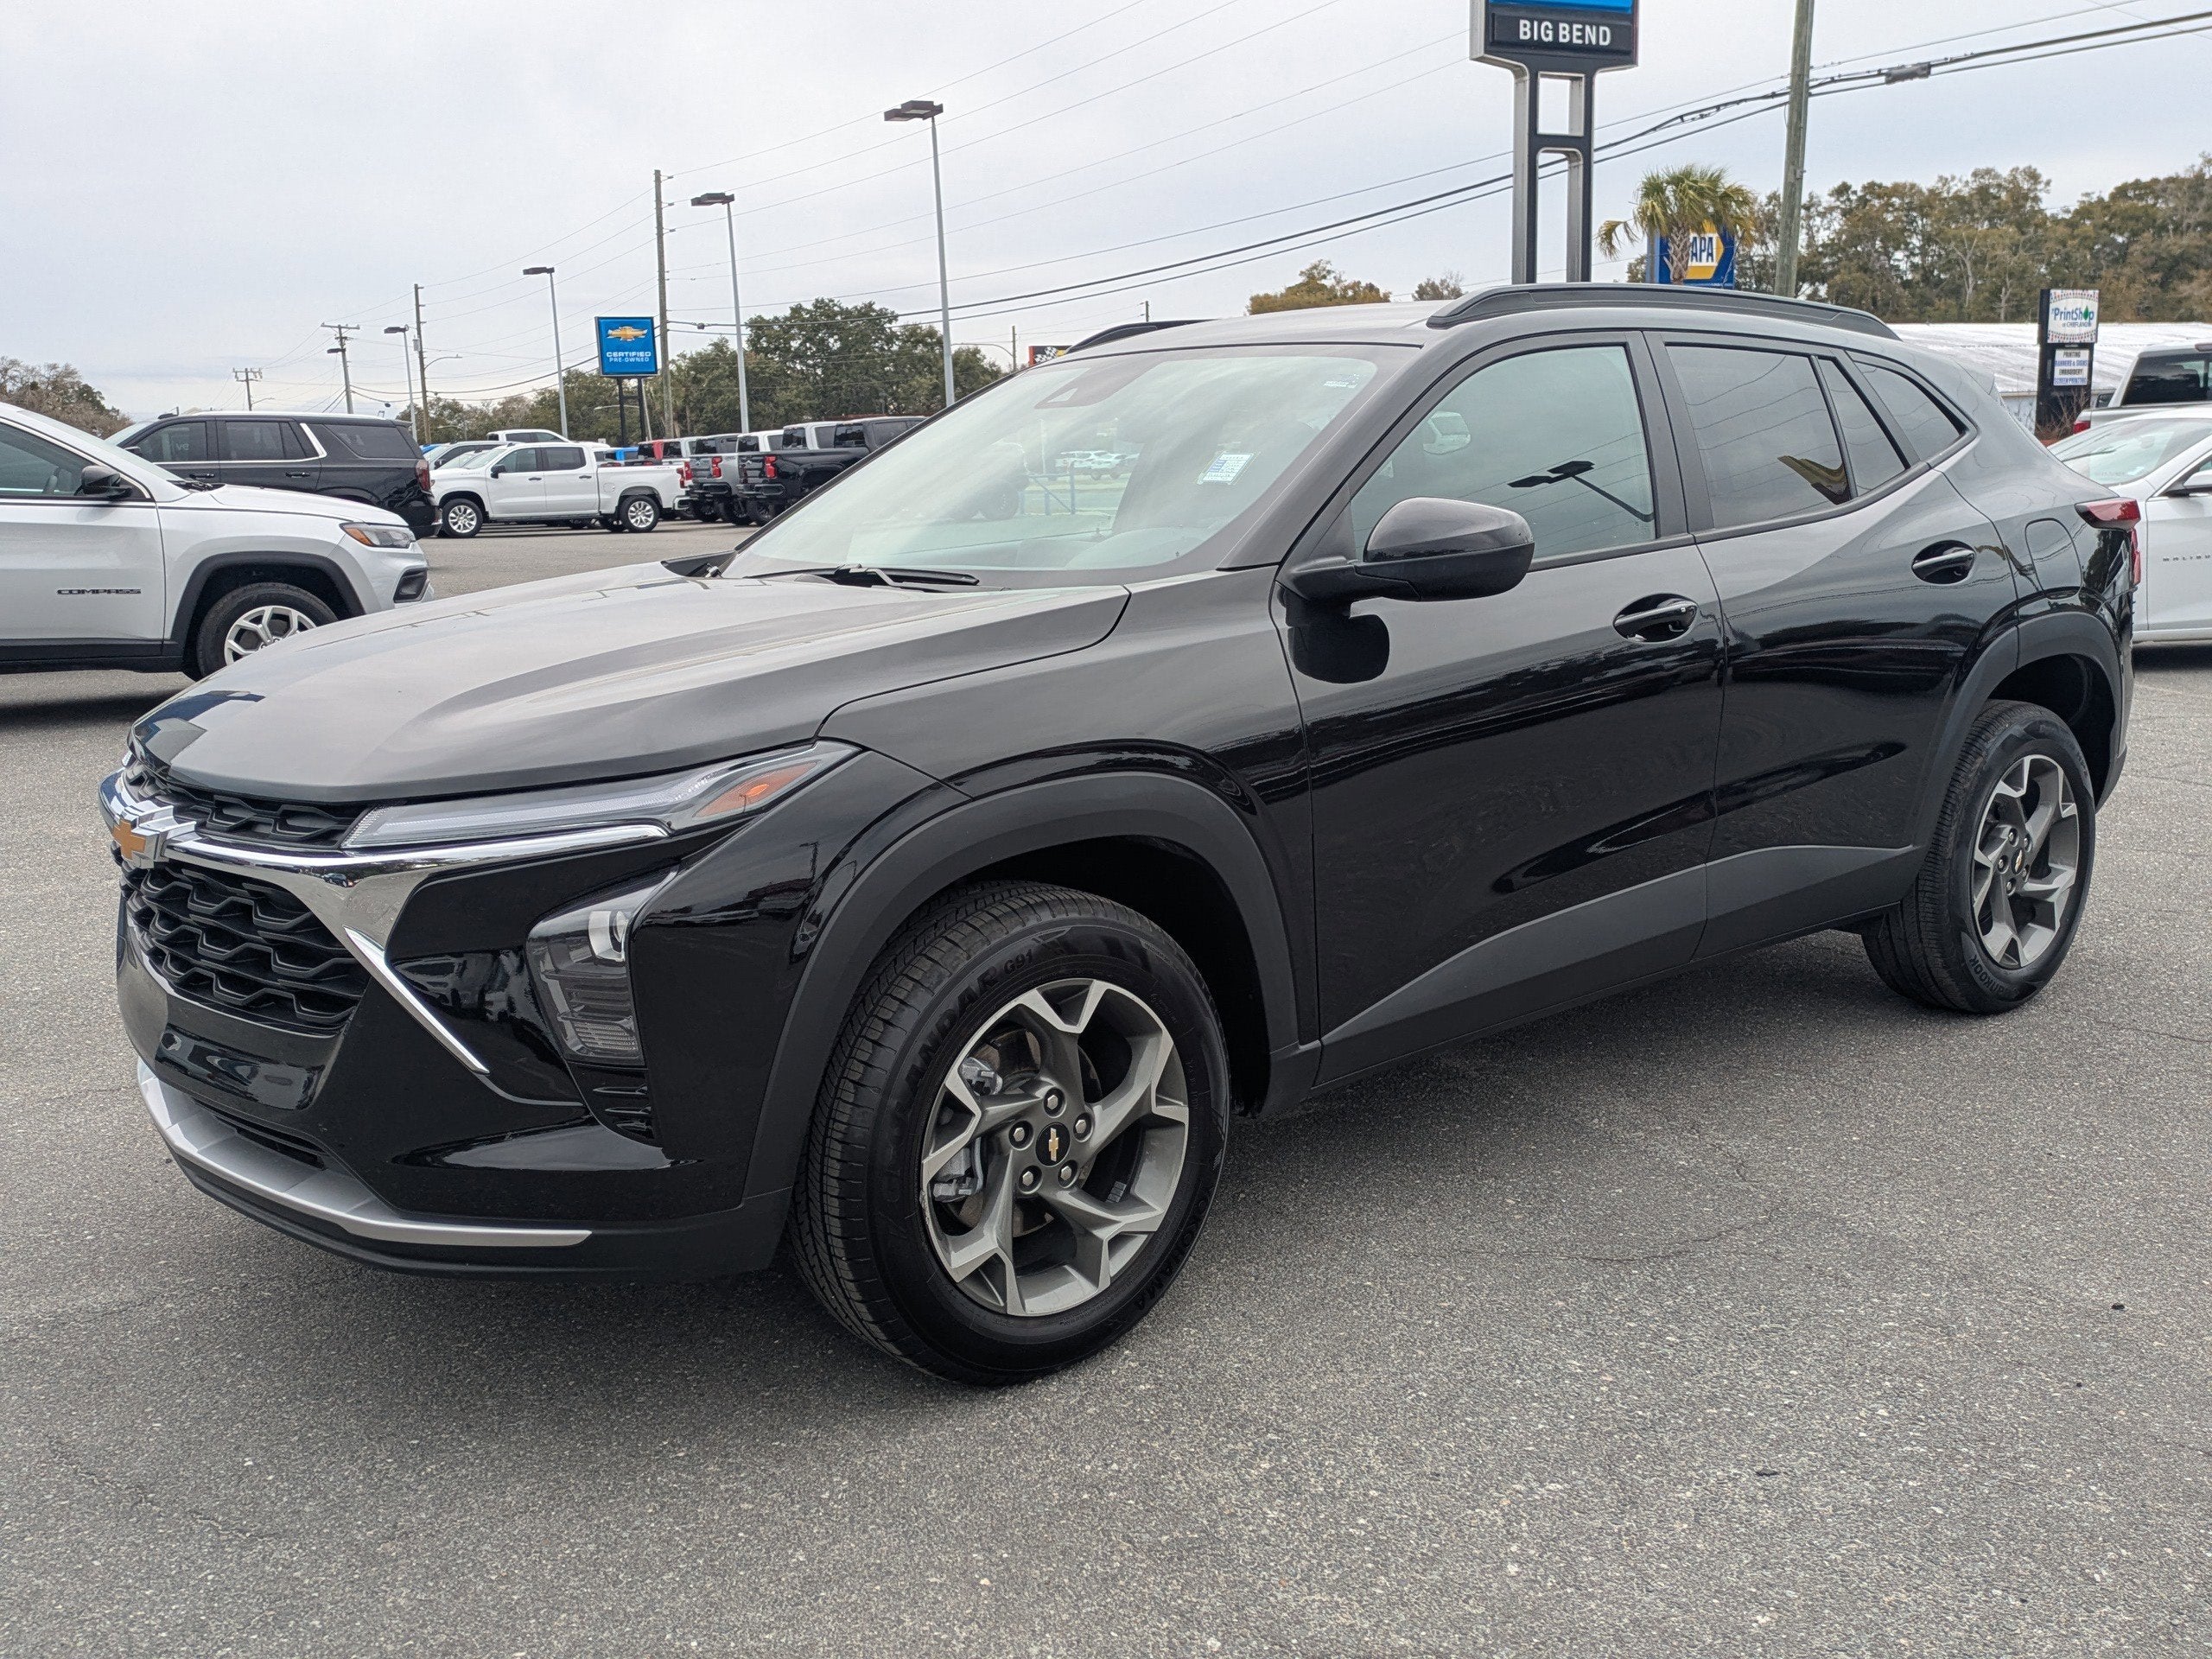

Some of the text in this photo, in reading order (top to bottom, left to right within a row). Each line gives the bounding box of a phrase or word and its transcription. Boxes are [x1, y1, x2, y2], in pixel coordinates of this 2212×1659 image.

[1519, 19, 1612, 46] BIG BEND
[1690, 236, 1714, 263] APA
[1004, 949, 1034, 976] G91
